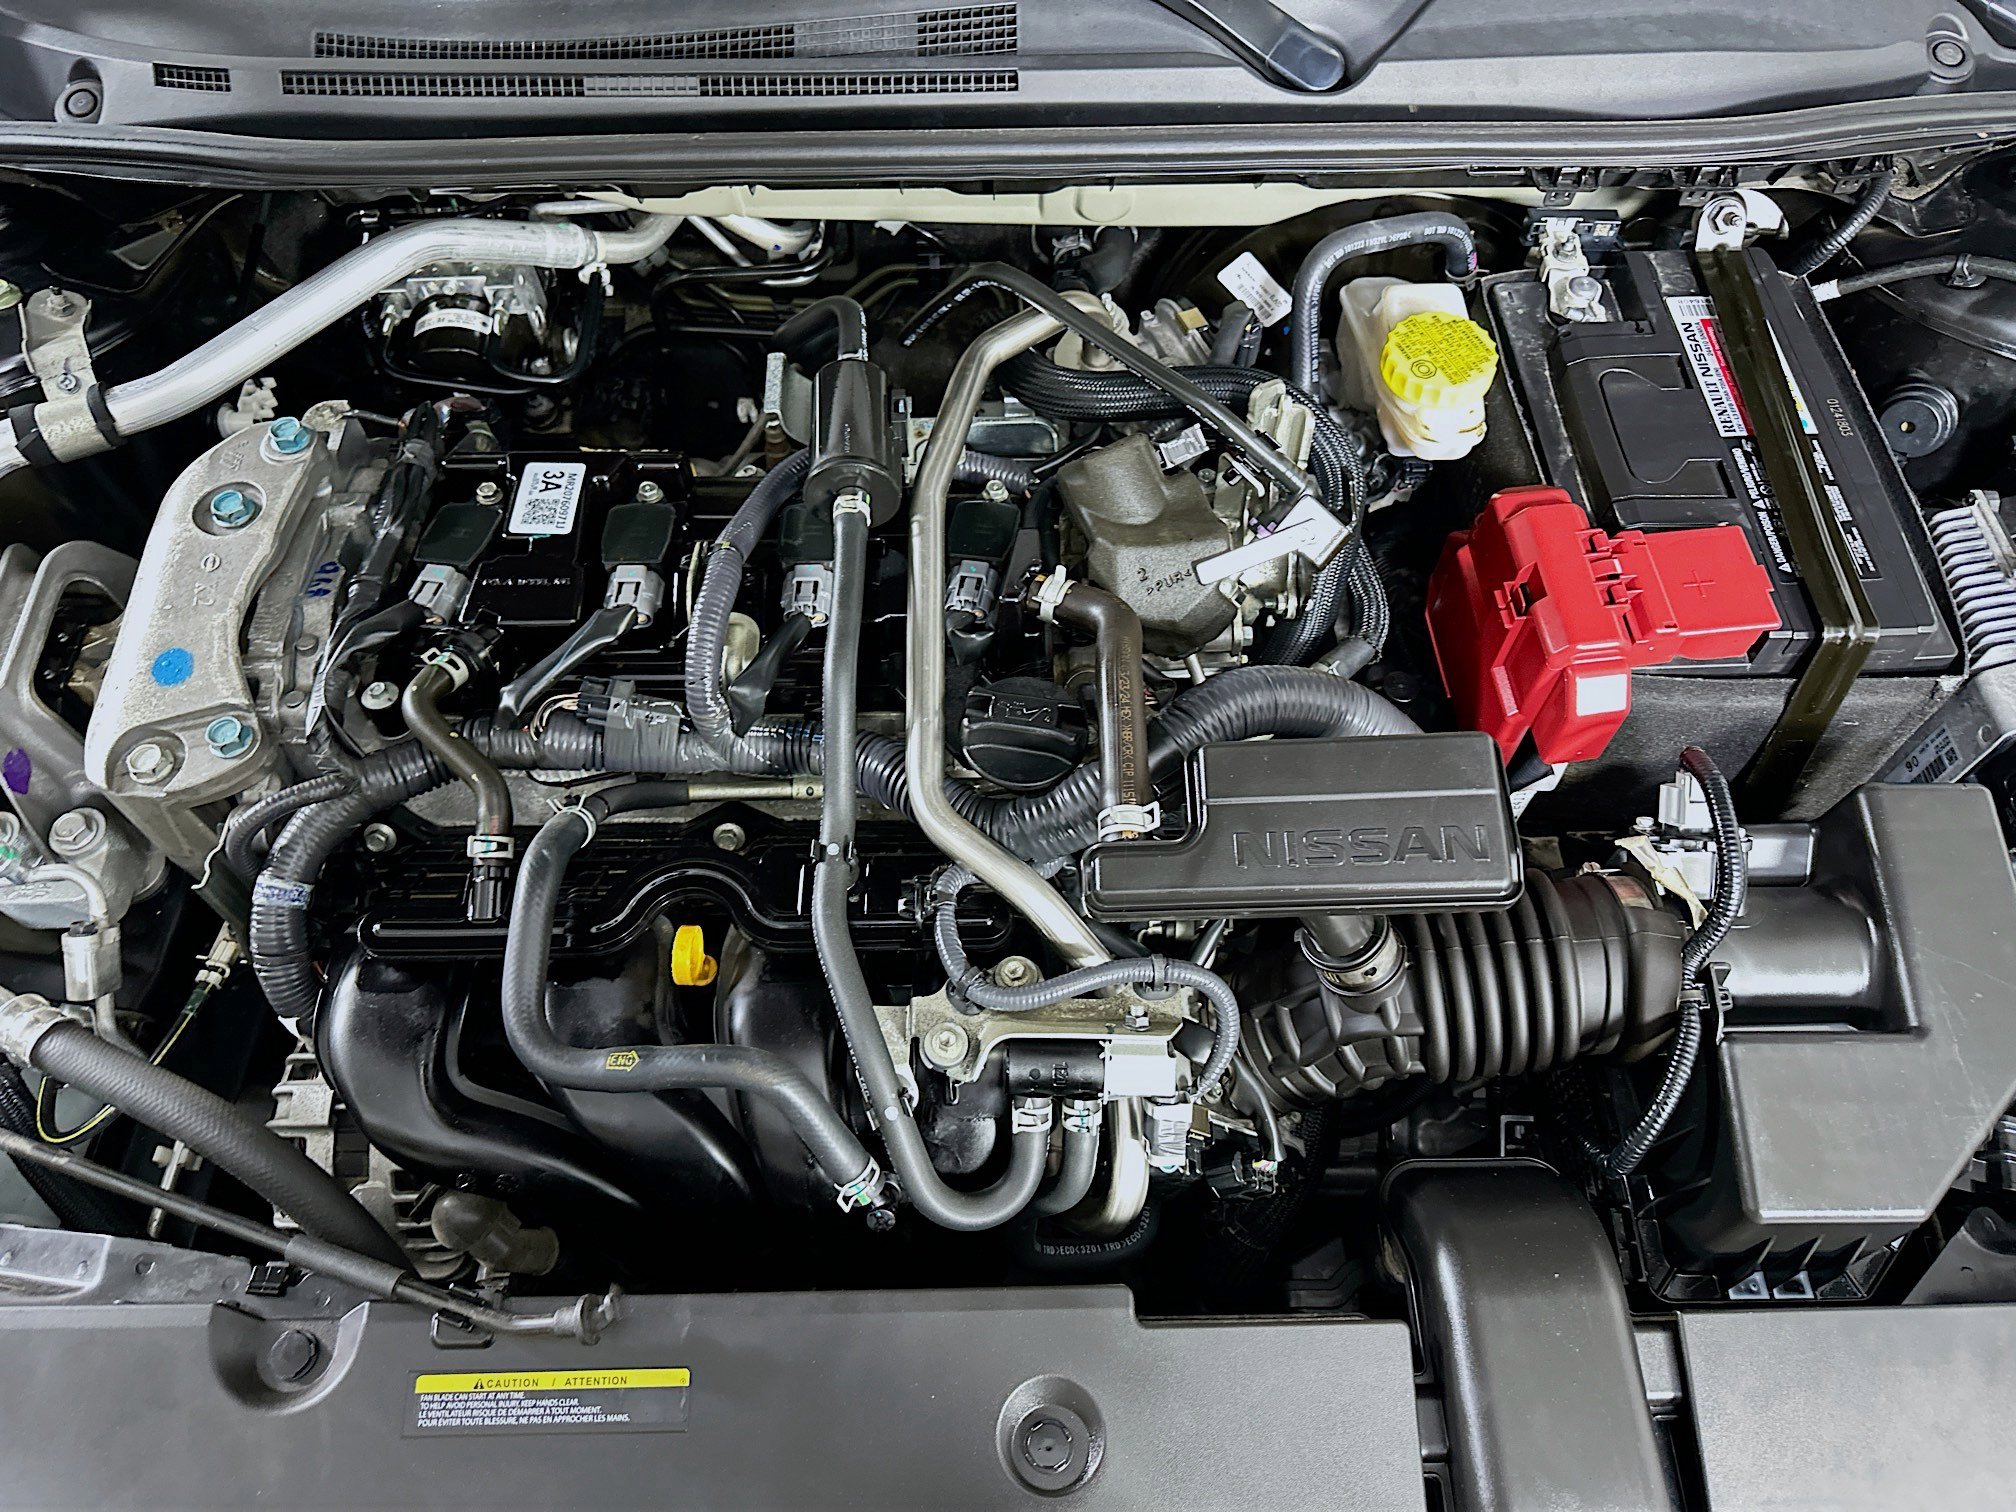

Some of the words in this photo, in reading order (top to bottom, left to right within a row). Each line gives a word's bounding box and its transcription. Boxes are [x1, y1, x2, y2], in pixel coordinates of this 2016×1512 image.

[1681, 322, 1713, 377] NISSAN
[1705, 381, 1737, 433] RENAULT
[539, 471, 564, 492] 3A
[1732, 447, 1760, 499] PELIGRO/VENENO
[1757, 511, 1787, 563] DANGER/POISON
[1233, 825, 1491, 868] NISSAN
[487, 1379, 538, 1388] CAUTION
[565, 1377, 627, 1386] ATTENTION
[419, 1410, 427, 1418] LE
[428, 1409, 472, 1418] VENTILATEUR
[472, 1409, 497, 1417] RISQUE
[446, 1401, 465, 1409] AVOID
[466, 1400, 498, 1408] PERSONAL
[520, 1399, 536, 1407] KEEP
[418, 1419, 438, 1427] POUR
[462, 1418, 483, 1426] TOUTE
[520, 1416, 528, 1424] NE
[529, 1416, 542, 1424] PAS
[552, 1415, 594, 1423] APPROCHER
[594, 1414, 606, 1422] LES
